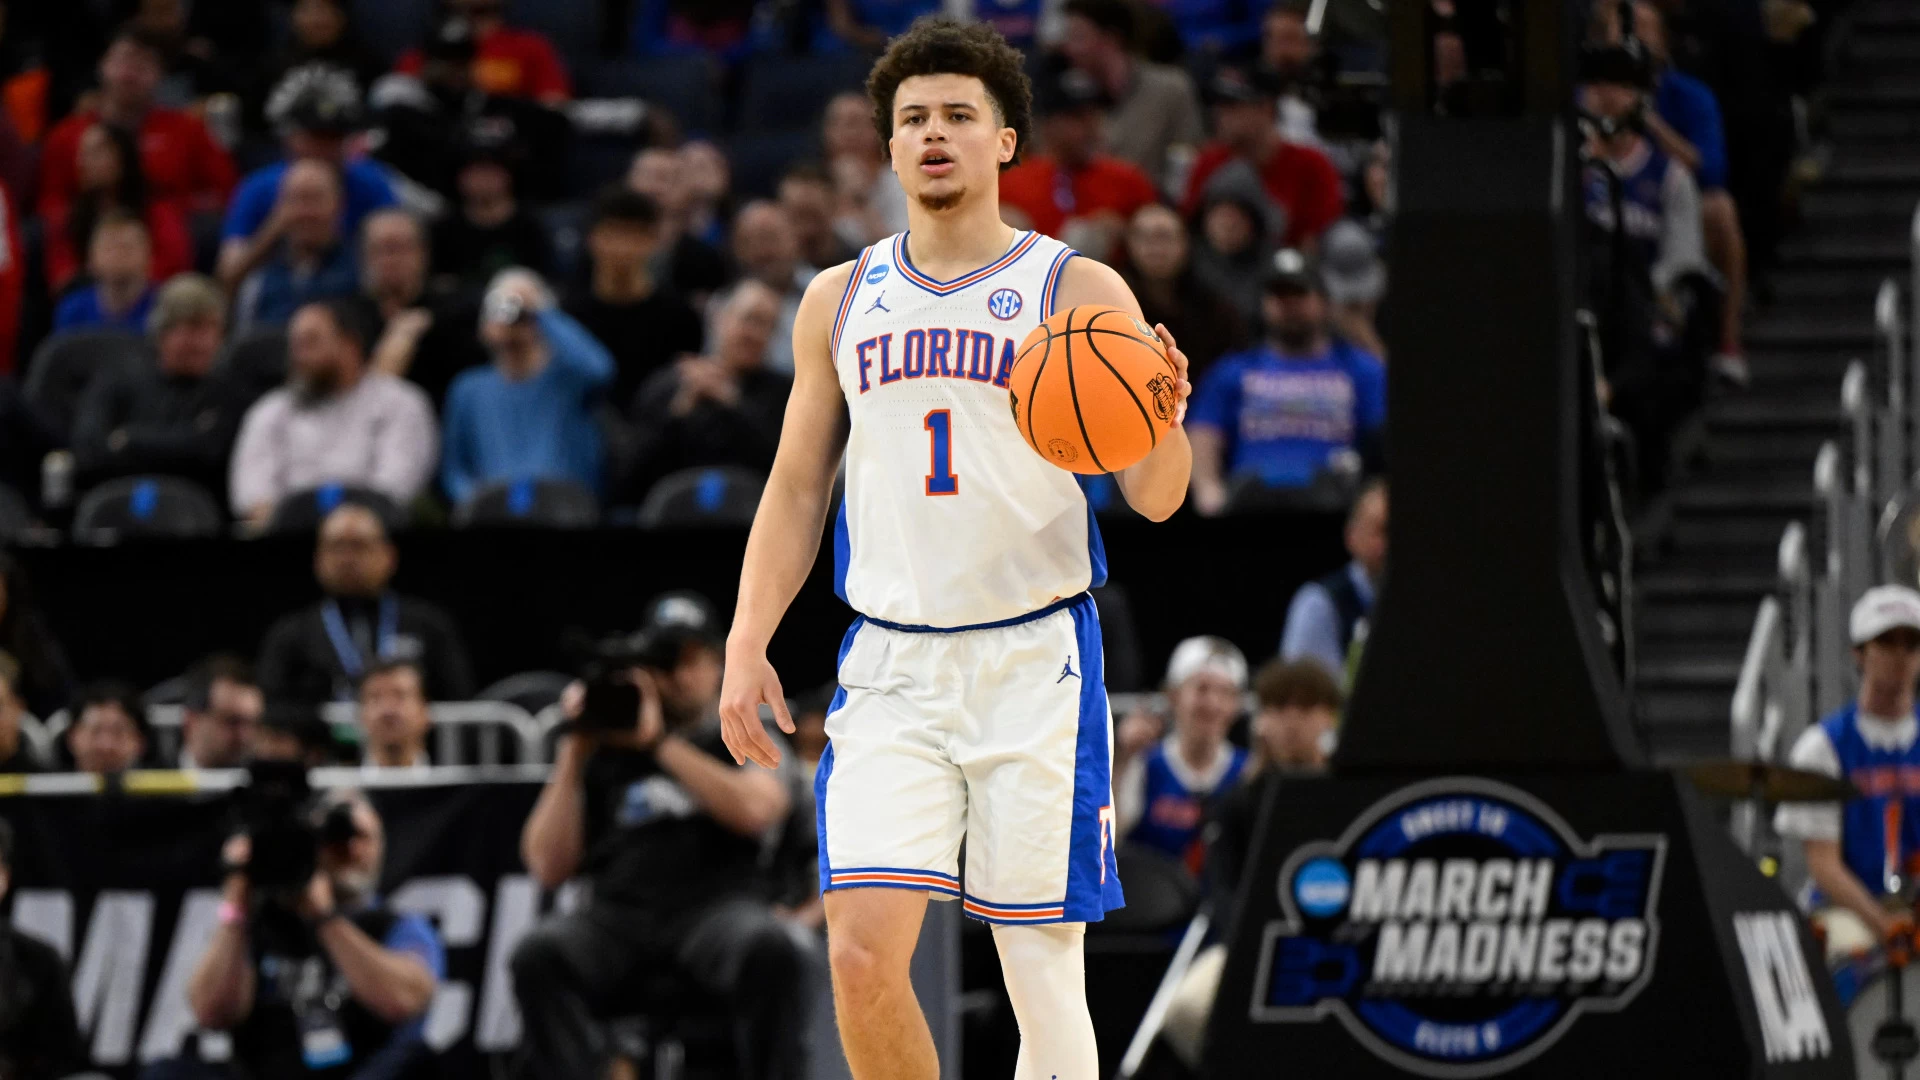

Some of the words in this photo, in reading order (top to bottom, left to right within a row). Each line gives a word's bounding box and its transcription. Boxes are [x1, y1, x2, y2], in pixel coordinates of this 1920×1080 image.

[990, 290, 1021, 318] SEC
[856, 328, 1017, 395] FLORIDA
[924, 409, 959, 496] 1
[1350, 857, 1553, 922] MARCH
[1373, 919, 1646, 984] MADNESS
